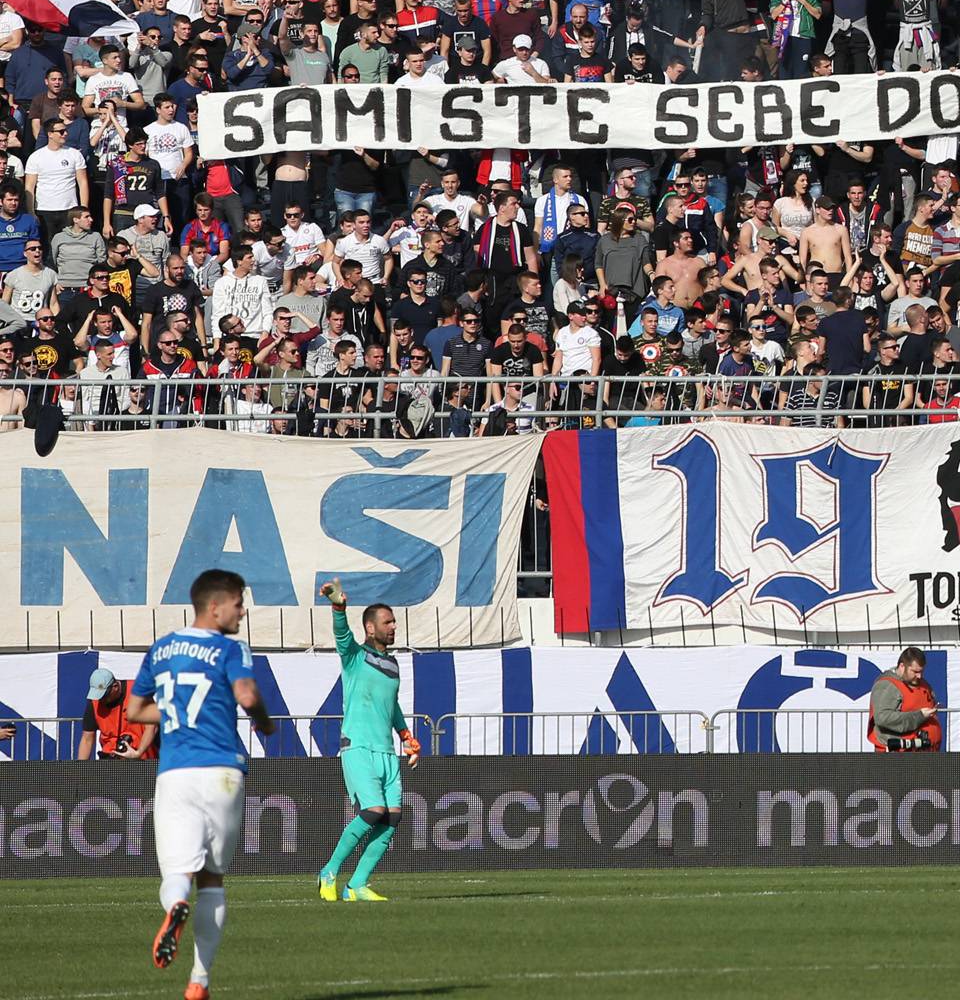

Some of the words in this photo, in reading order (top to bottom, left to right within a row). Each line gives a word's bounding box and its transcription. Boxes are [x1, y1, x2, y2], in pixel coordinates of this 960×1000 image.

[222, 86, 414, 153] SAMI
[439, 86, 611, 144] STE
[653, 80, 841, 144] SEBE
[127, 175, 148, 191] 72
[20, 446, 506, 608] NAŠI
[153, 670, 213, 735] 37
